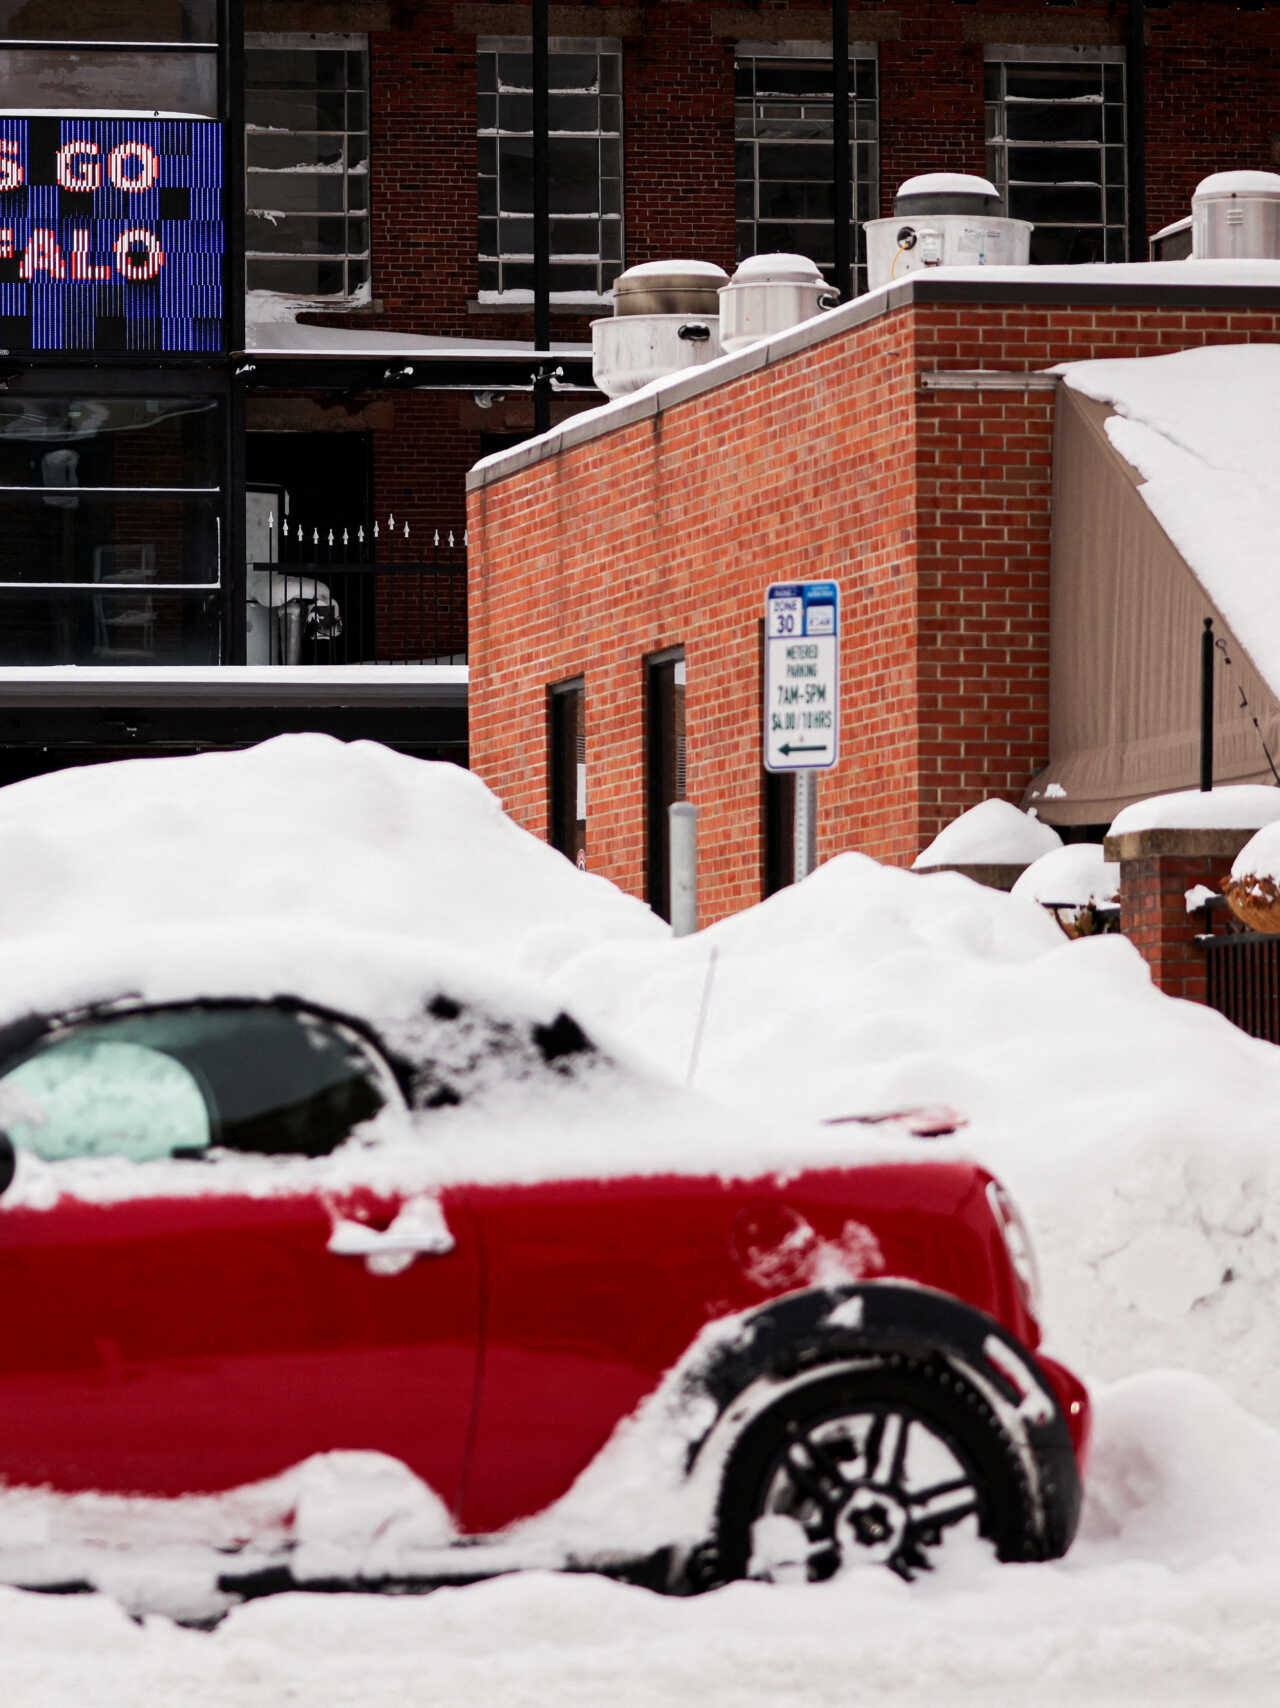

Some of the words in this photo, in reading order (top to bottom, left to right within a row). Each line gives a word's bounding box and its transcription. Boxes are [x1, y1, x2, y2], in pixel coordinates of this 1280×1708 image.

[56, 140, 158, 192] GO
[774, 600, 797, 611] ZONE
[777, 614, 794, 634] 30
[786, 645, 818, 659] METERED
[787, 663, 817, 677] PARKING
[778, 683, 826, 704] 7AM-5PM
